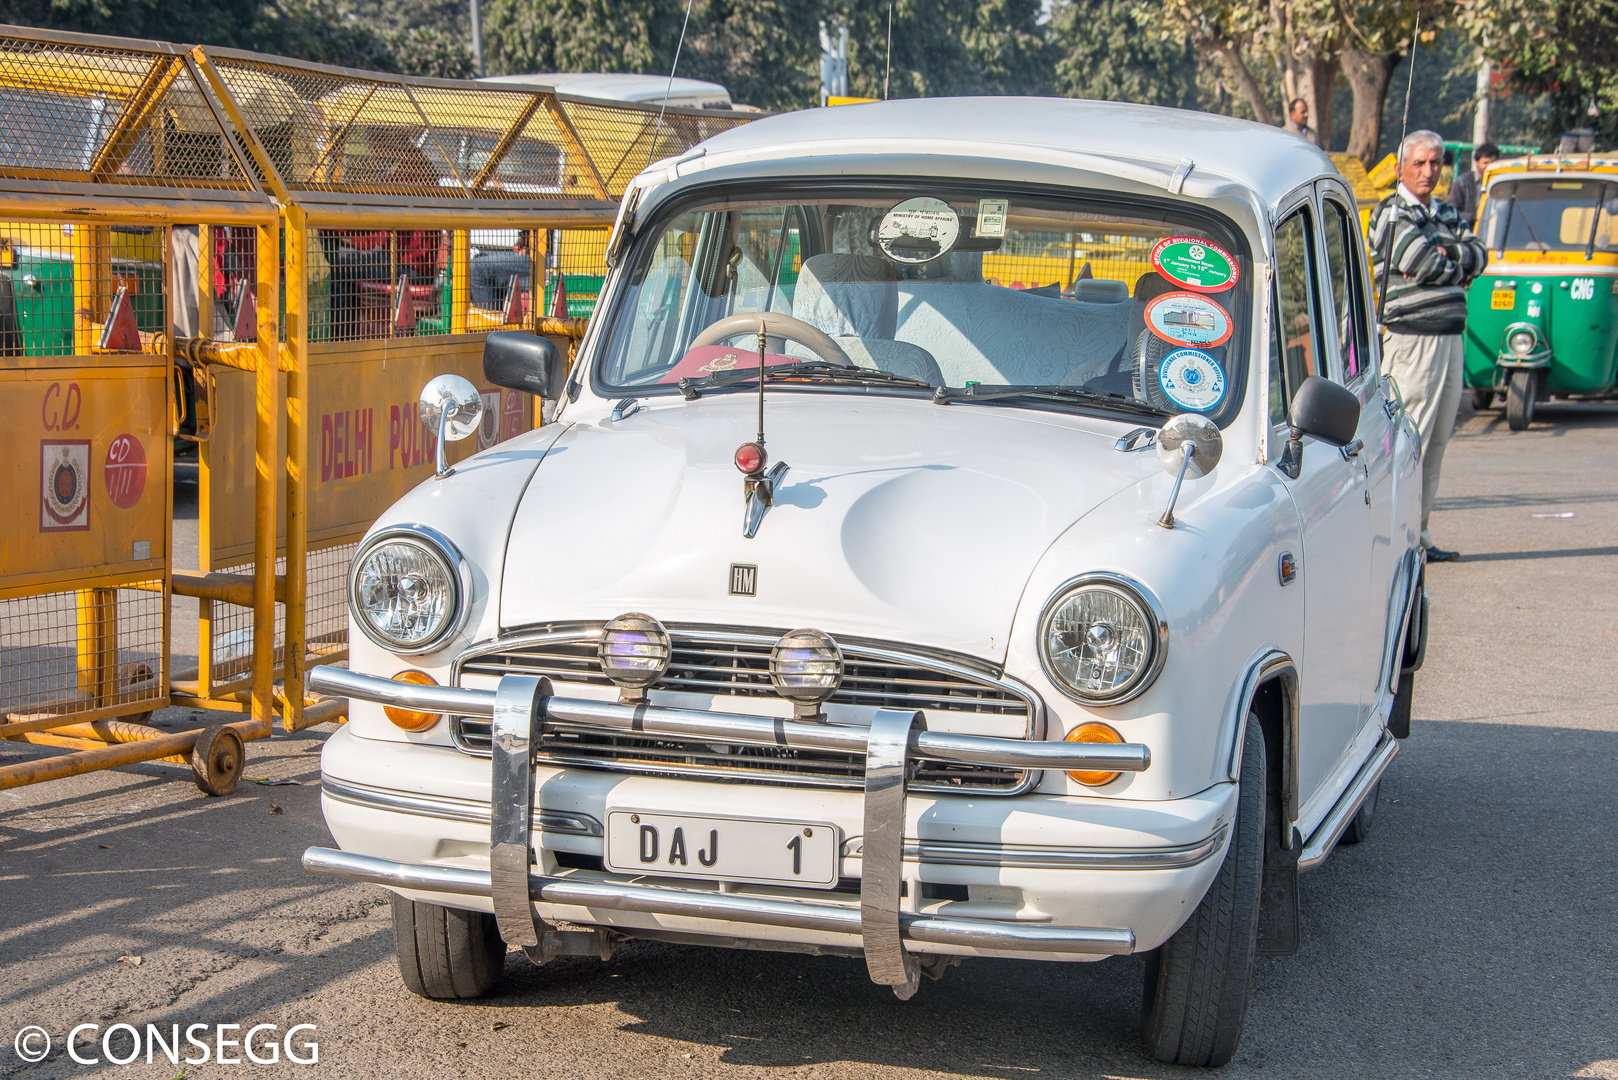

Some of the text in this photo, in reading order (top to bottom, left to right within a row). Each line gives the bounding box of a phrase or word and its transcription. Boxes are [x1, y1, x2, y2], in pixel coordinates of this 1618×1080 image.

[1154, 245, 1164, 265] OFFICE
[1172, 237, 1208, 247] DIVISIONAL
[1209, 244, 1236, 282] COMMISSIONER
[1170, 260, 1190, 269] January
[1208, 270, 1227, 278] January
[1570, 278, 1595, 300] CNG
[1162, 355, 1177, 379] DIVISIONAL
[1175, 351, 1215, 367] COMMISSIONER
[1212, 366, 1223, 383] OFFICE
[42, 382, 82, 432] C.D.
[110, 437, 131, 463] CD
[321, 407, 373, 483] DELHI
[732, 567, 755, 594] HM
[639, 824, 801, 875] DAJ 1
